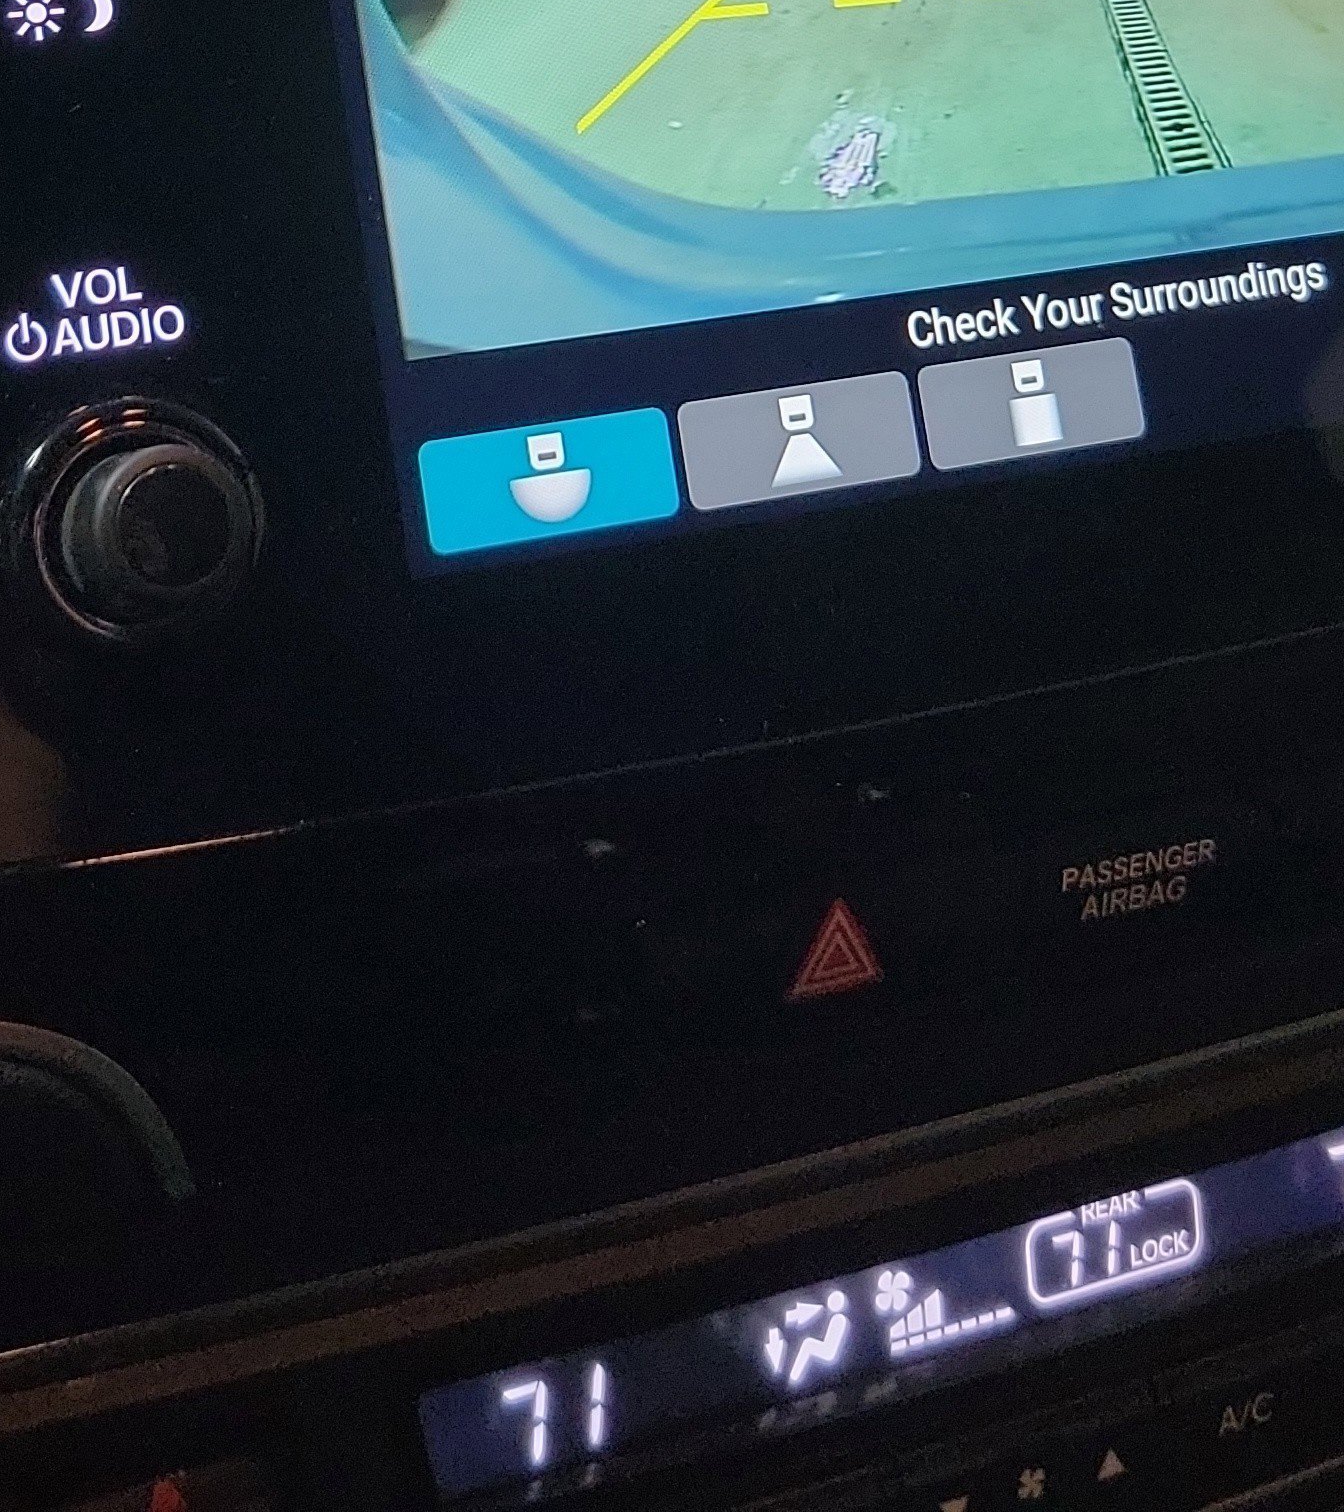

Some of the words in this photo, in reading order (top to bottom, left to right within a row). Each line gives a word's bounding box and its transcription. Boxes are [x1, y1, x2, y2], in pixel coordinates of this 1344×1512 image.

[51, 266, 143, 308] VOL
[906, 298, 1019, 349] Check
[1020, 290, 1105, 332] Your
[1109, 261, 1328, 320] Surroundings
[51, 303, 187, 357] AUDIO
[1061, 839, 1217, 892] PASSENGER
[1081, 876, 1188, 921] AIRBAG
[1081, 1189, 1141, 1224] REAR
[1051, 1219, 1124, 1288] 71
[1130, 1228, 1190, 1269] LOCK
[500, 1361, 609, 1468] 71
[1218, 1392, 1274, 1437] A/C
